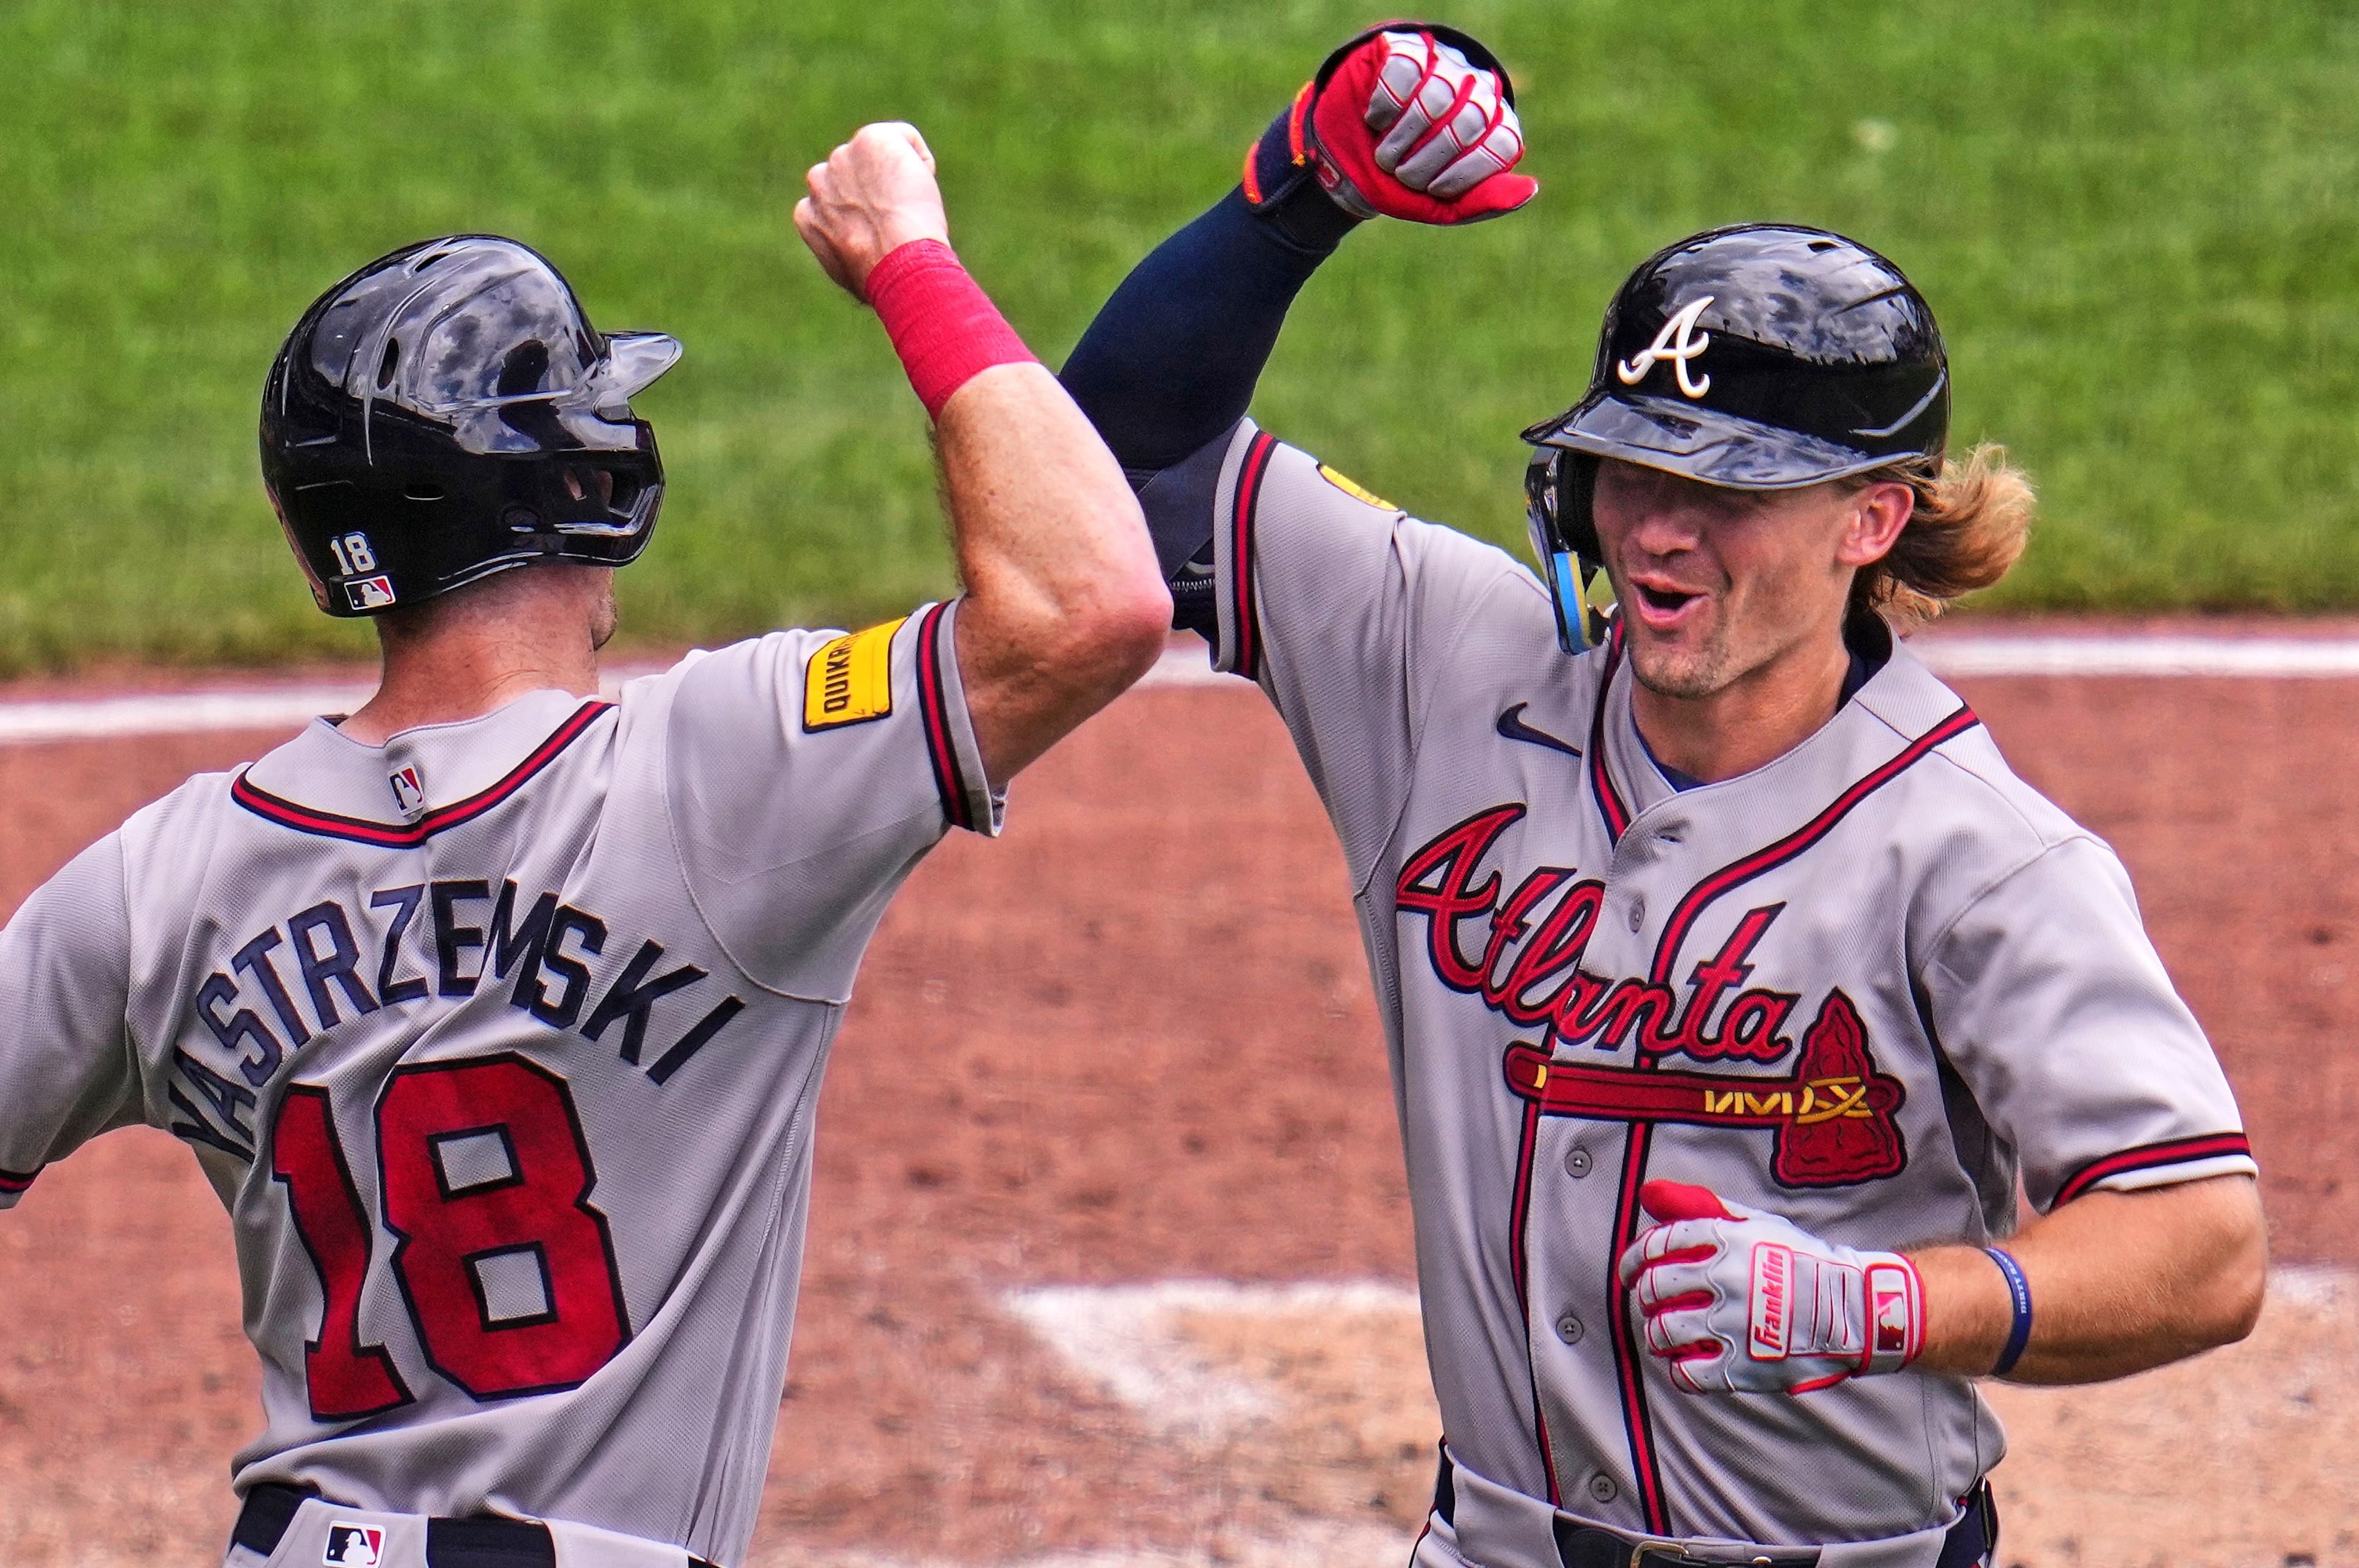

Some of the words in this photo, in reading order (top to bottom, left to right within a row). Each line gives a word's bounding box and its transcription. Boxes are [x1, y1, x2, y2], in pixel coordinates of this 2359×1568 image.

[1618, 295, 1715, 399] A
[331, 531, 377, 575] 18
[824, 633, 863, 714] QUIKR
[1395, 803, 1801, 1065] Atlanta
[168, 878, 746, 1166] YASTRZEMSKI
[272, 1050, 633, 1422] 18
[1754, 1249, 1784, 1351] Franklin
